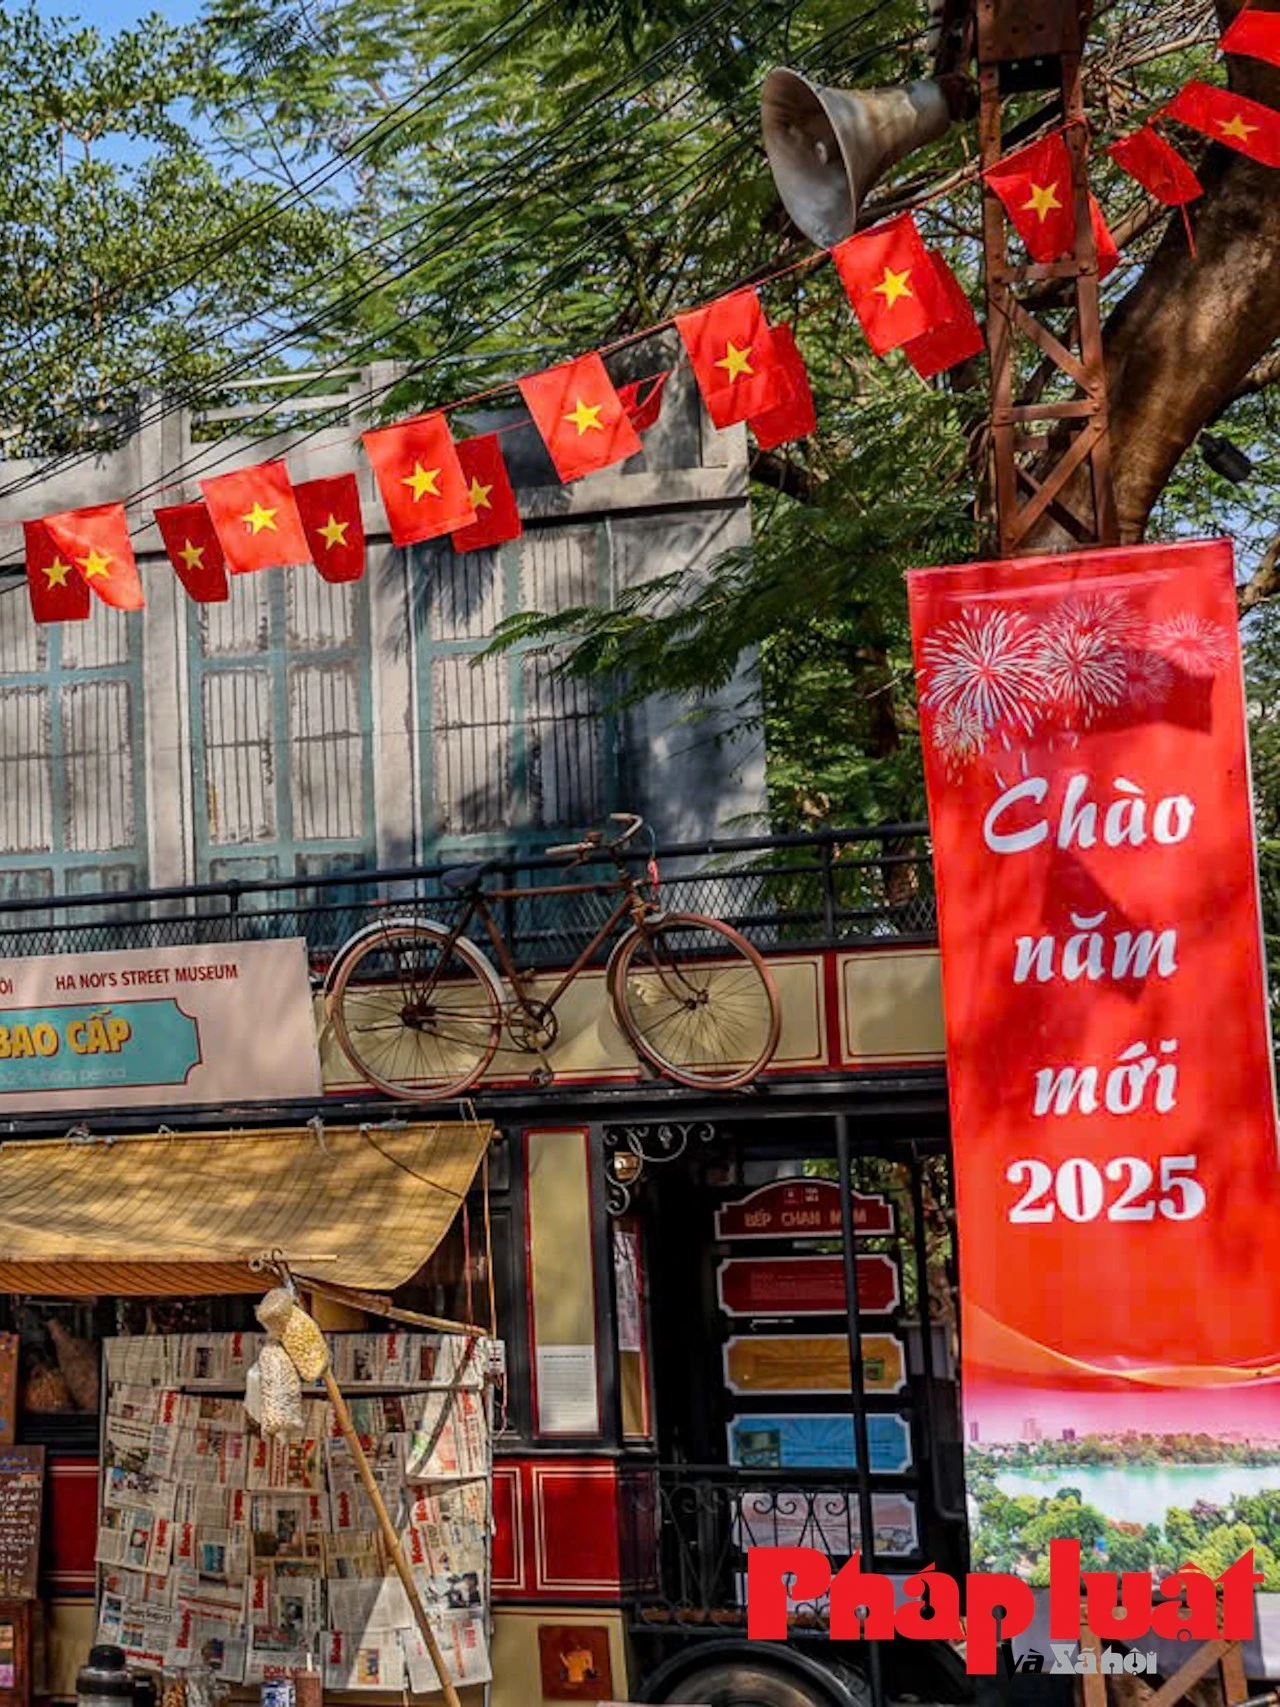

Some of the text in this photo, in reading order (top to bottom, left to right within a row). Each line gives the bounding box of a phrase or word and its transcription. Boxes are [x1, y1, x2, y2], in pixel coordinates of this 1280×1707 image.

[982, 774, 1196, 855] Chào
[121, 968, 170, 985] STREET
[175, 964, 238, 982] MUSEUM
[1012, 910, 1179, 985] năm
[65, 1007, 132, 1055] CẤP
[1032, 1039, 1179, 1117] mới
[1005, 1154, 1207, 1224] 2025
